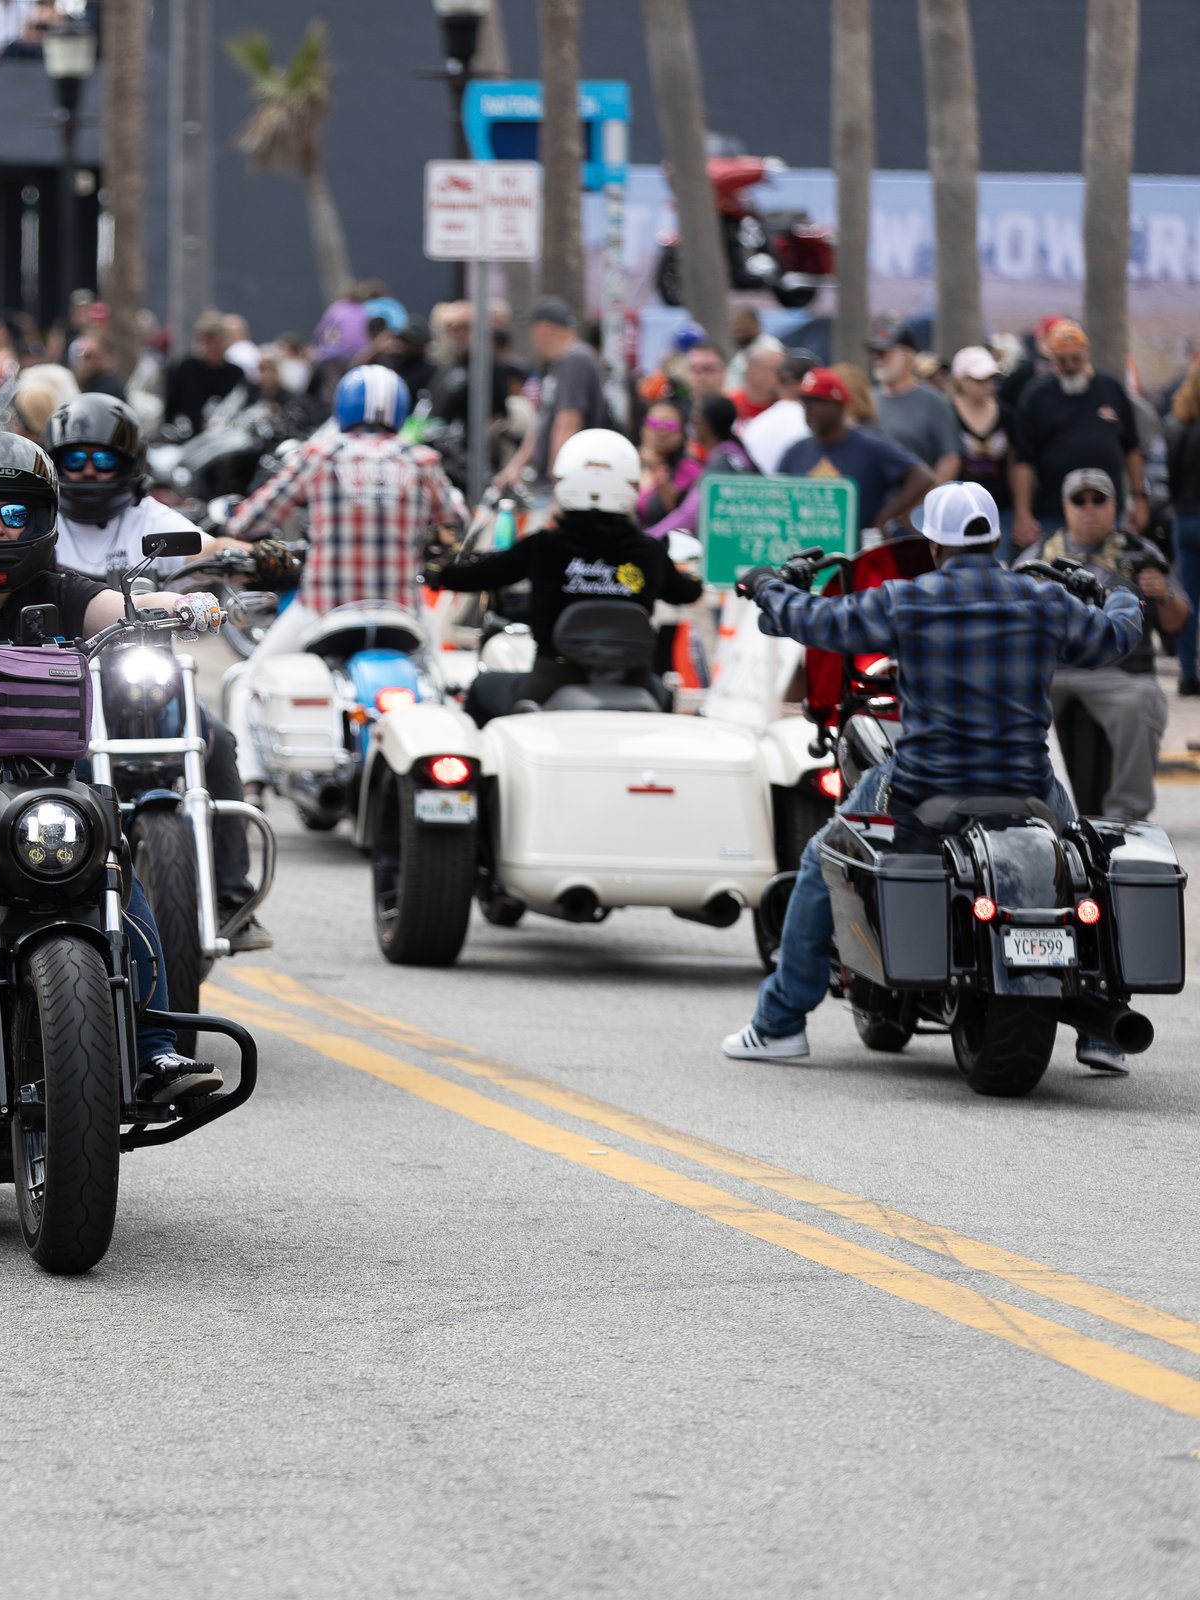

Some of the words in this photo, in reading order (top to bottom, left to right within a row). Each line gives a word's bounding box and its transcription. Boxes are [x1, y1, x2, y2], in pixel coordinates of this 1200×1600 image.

[718, 485, 835, 502] MOTORCYCLE
[714, 500, 792, 519] PARKING
[798, 503, 841, 521] WITH
[712, 517, 781, 538] RETURN
[786, 519, 842, 539] ENTRY
[1014, 929, 1064, 939] GEORGIA
[1013, 938, 1063, 956] YCF599
